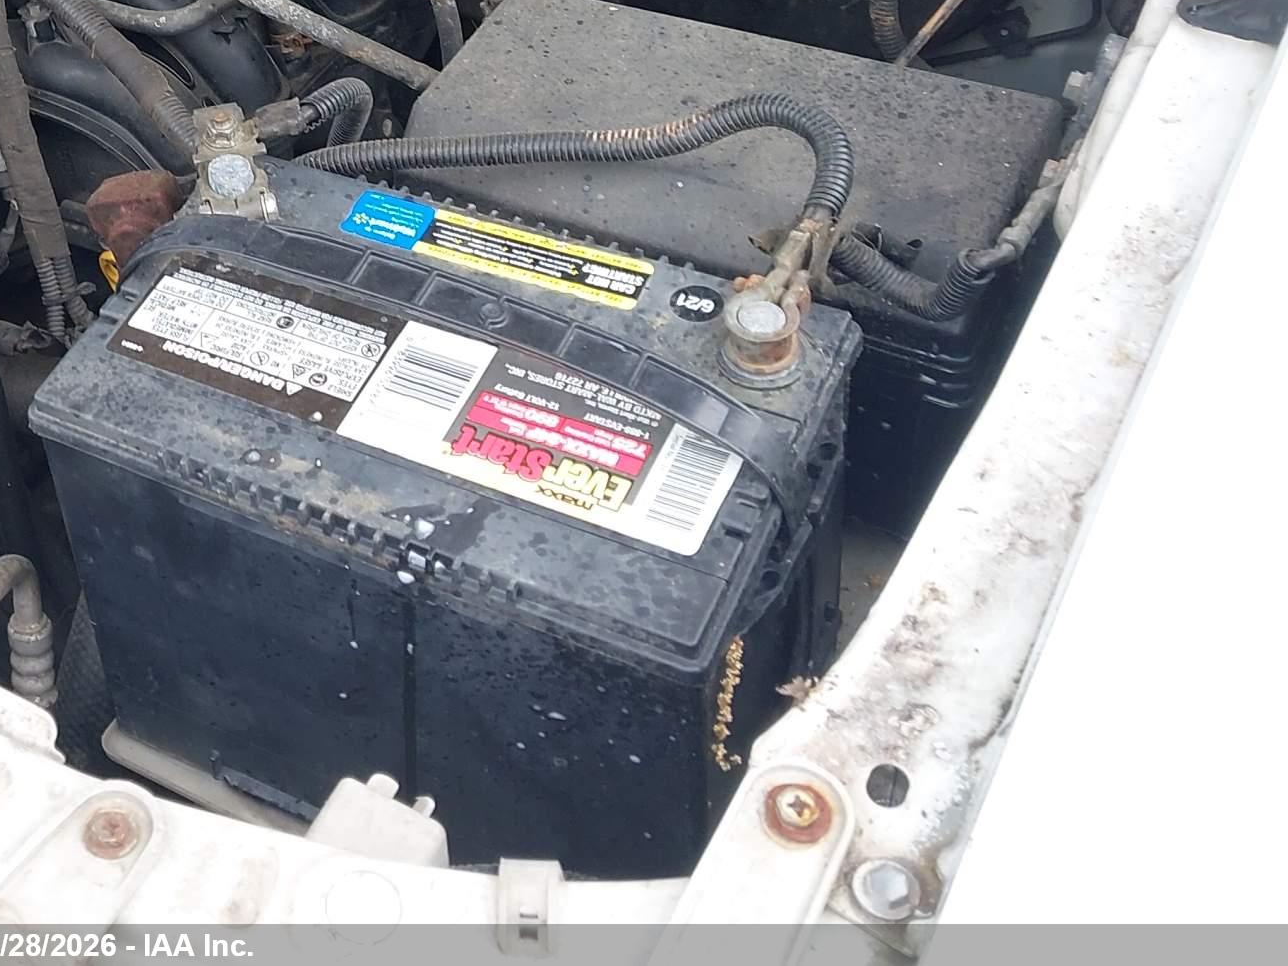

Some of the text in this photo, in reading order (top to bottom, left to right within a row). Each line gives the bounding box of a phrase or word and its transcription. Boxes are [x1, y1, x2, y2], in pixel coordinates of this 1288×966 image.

[675, 292, 715, 314] 6/21
[159, 339, 288, 391] DANGER/POISON
[564, 382, 618, 406] WAL-MART
[582, 380, 600, 392] AR
[615, 399, 633, 411] BY
[532, 484, 595, 511] maxx
